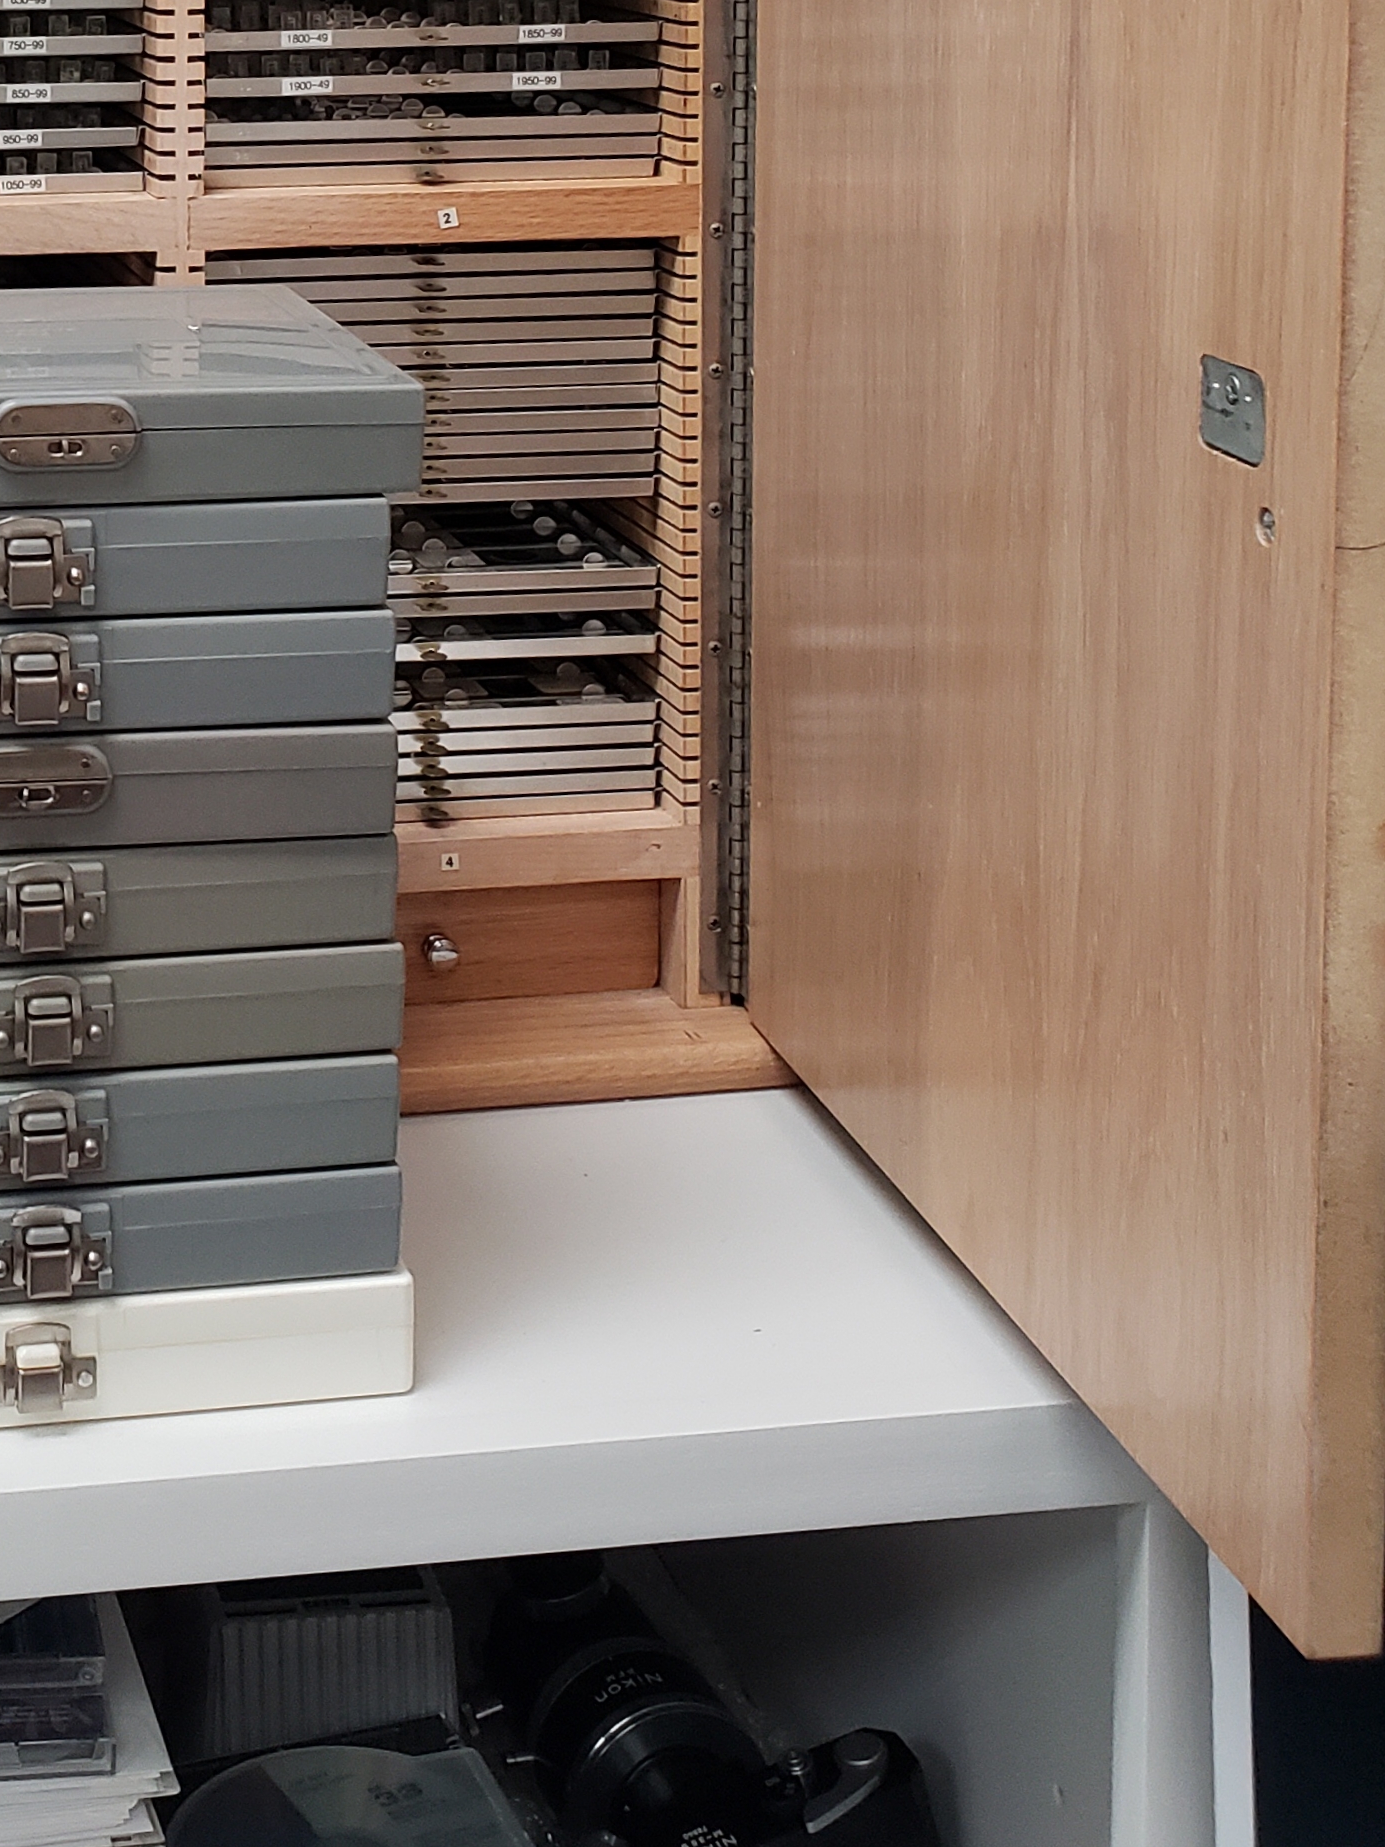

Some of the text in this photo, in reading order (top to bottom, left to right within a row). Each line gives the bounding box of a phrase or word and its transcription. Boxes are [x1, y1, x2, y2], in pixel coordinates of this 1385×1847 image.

[286, 28, 562, 44] 1800-49 1850-99
[8, 40, 44, 50] 750-99
[289, 75, 557, 91] 1900-49 1950-99
[12, 89, 48, 99] 850-99
[3, 135, 39, 145] 950-99
[1, 179, 42, 191] 1050-99
[443, 213, 452, 224] 2
[446, 856, 453, 867] 4
